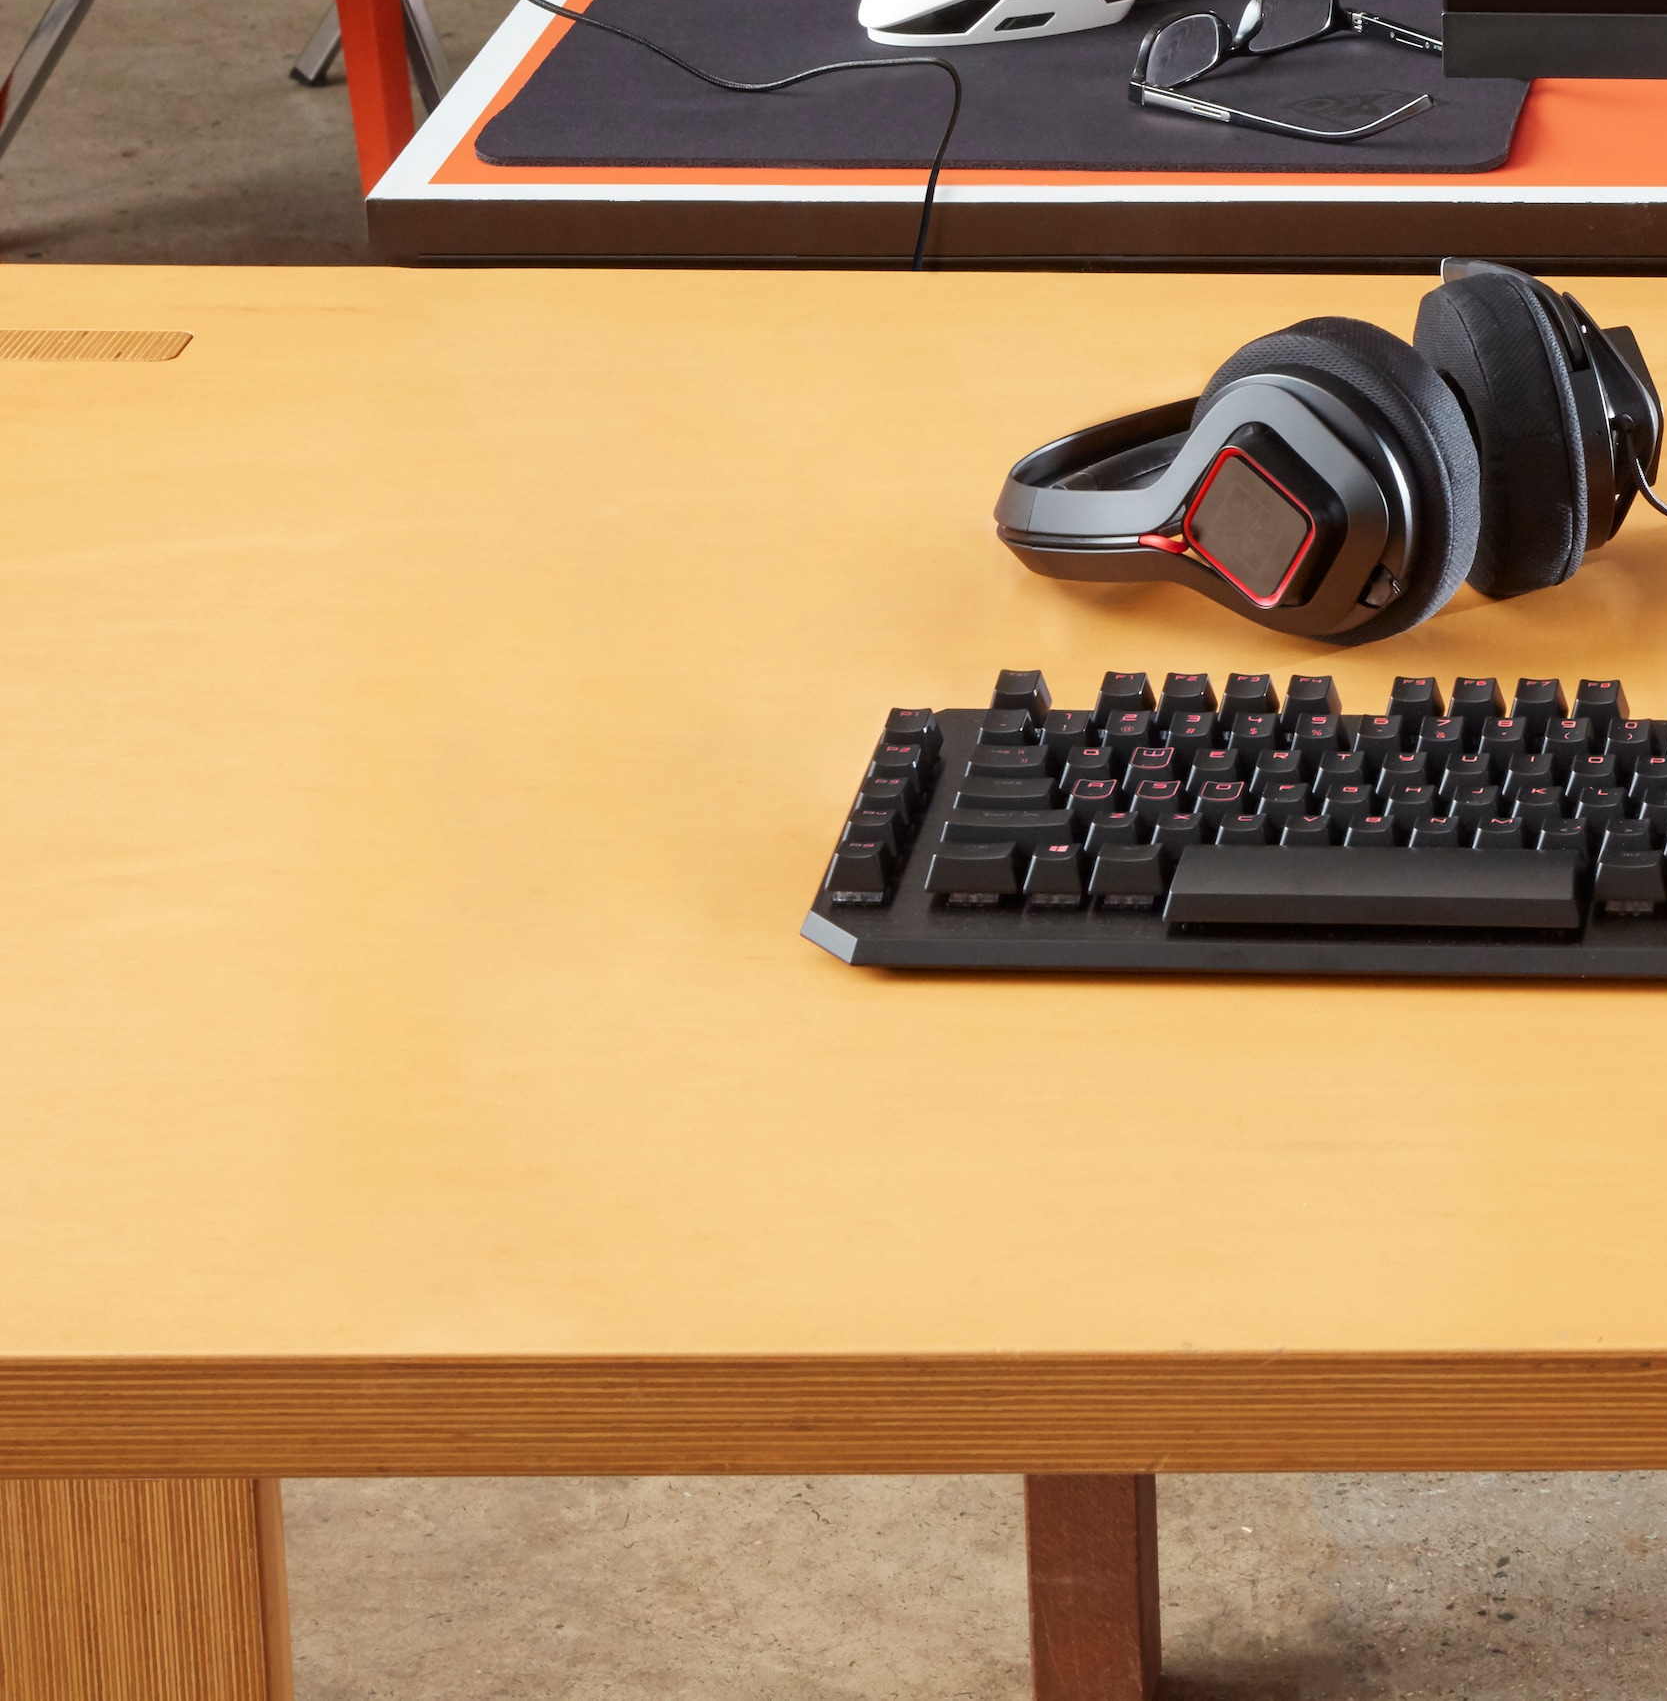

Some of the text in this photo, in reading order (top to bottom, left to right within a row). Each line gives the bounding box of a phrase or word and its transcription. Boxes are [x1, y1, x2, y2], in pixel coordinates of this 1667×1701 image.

[1209, 750, 1225, 758] E
[1273, 752, 1289, 760] R
[1337, 753, 1351, 761] T
[1462, 755, 1478, 763] U
